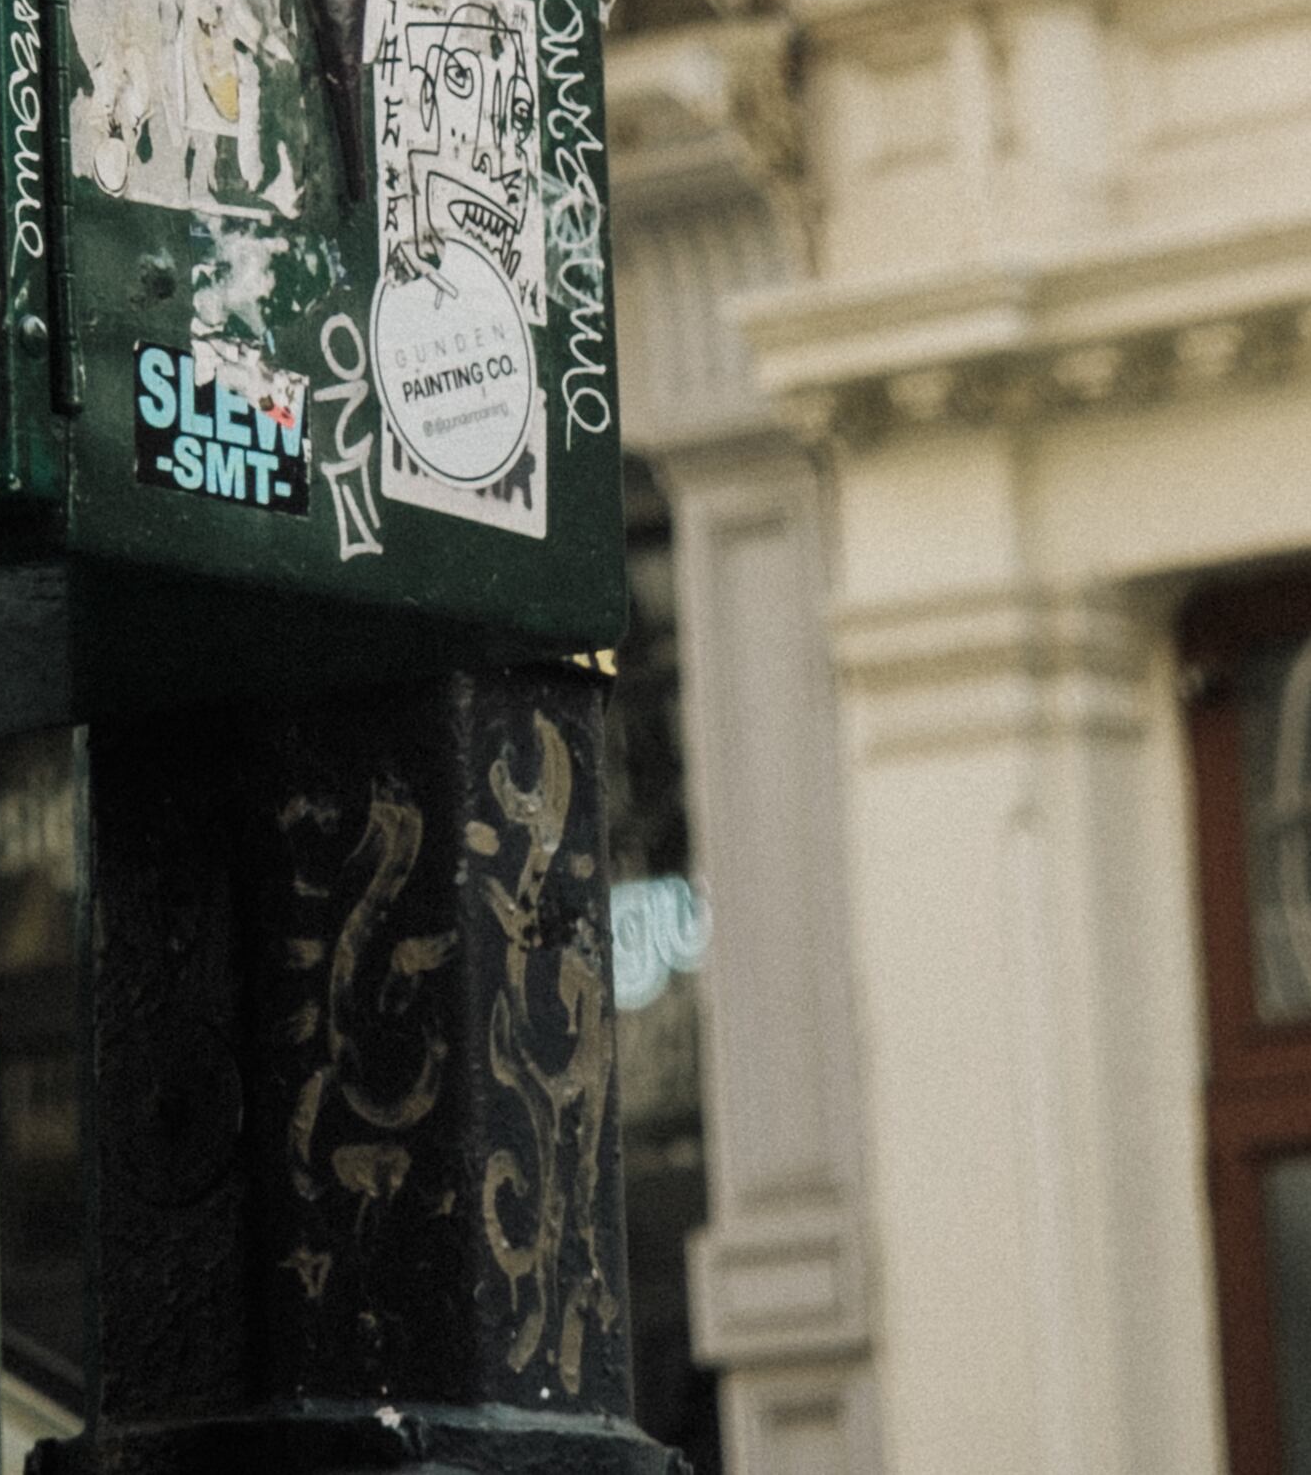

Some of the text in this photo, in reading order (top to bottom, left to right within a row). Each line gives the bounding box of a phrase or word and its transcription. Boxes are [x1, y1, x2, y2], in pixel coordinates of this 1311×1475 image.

[138, 346, 306, 458] SLEW
[401, 354, 518, 404] PAINTING CO.
